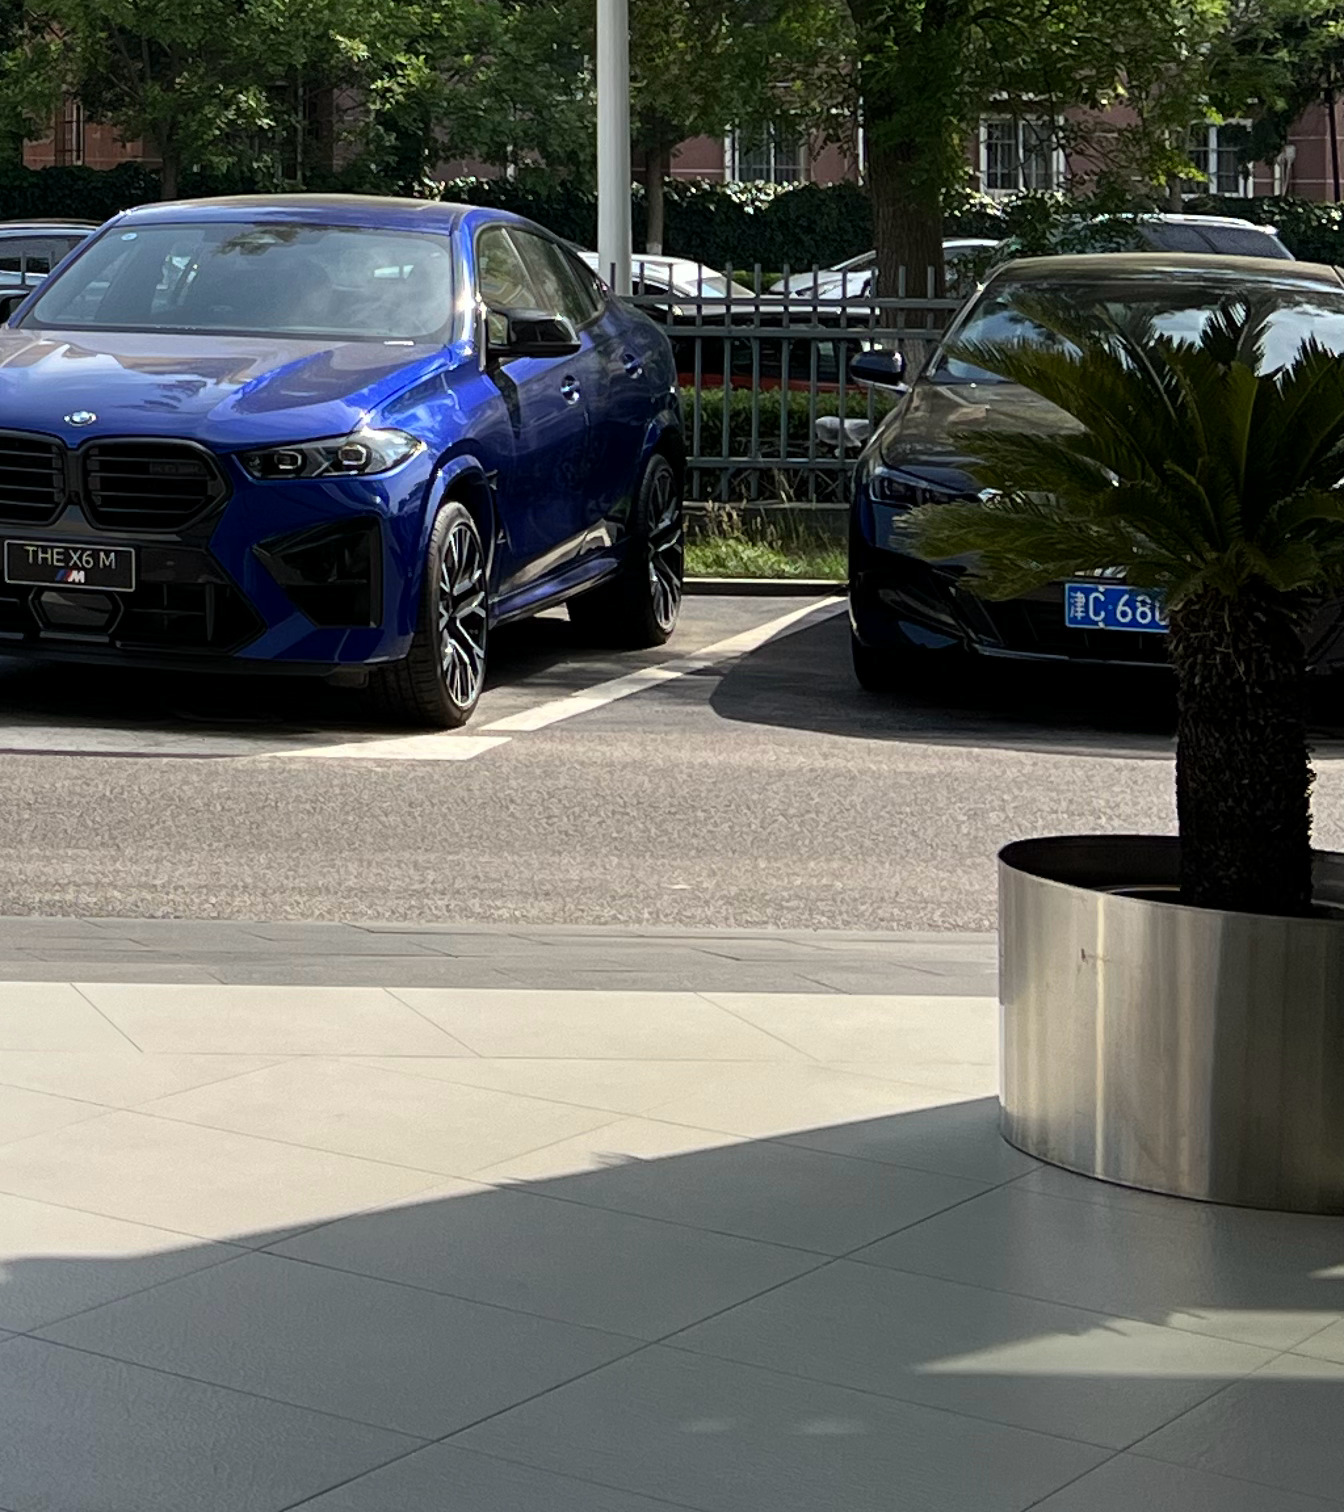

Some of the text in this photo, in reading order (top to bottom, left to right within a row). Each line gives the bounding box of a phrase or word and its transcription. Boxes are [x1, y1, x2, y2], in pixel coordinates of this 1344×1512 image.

[24, 546, 116, 569] THE X6 M
